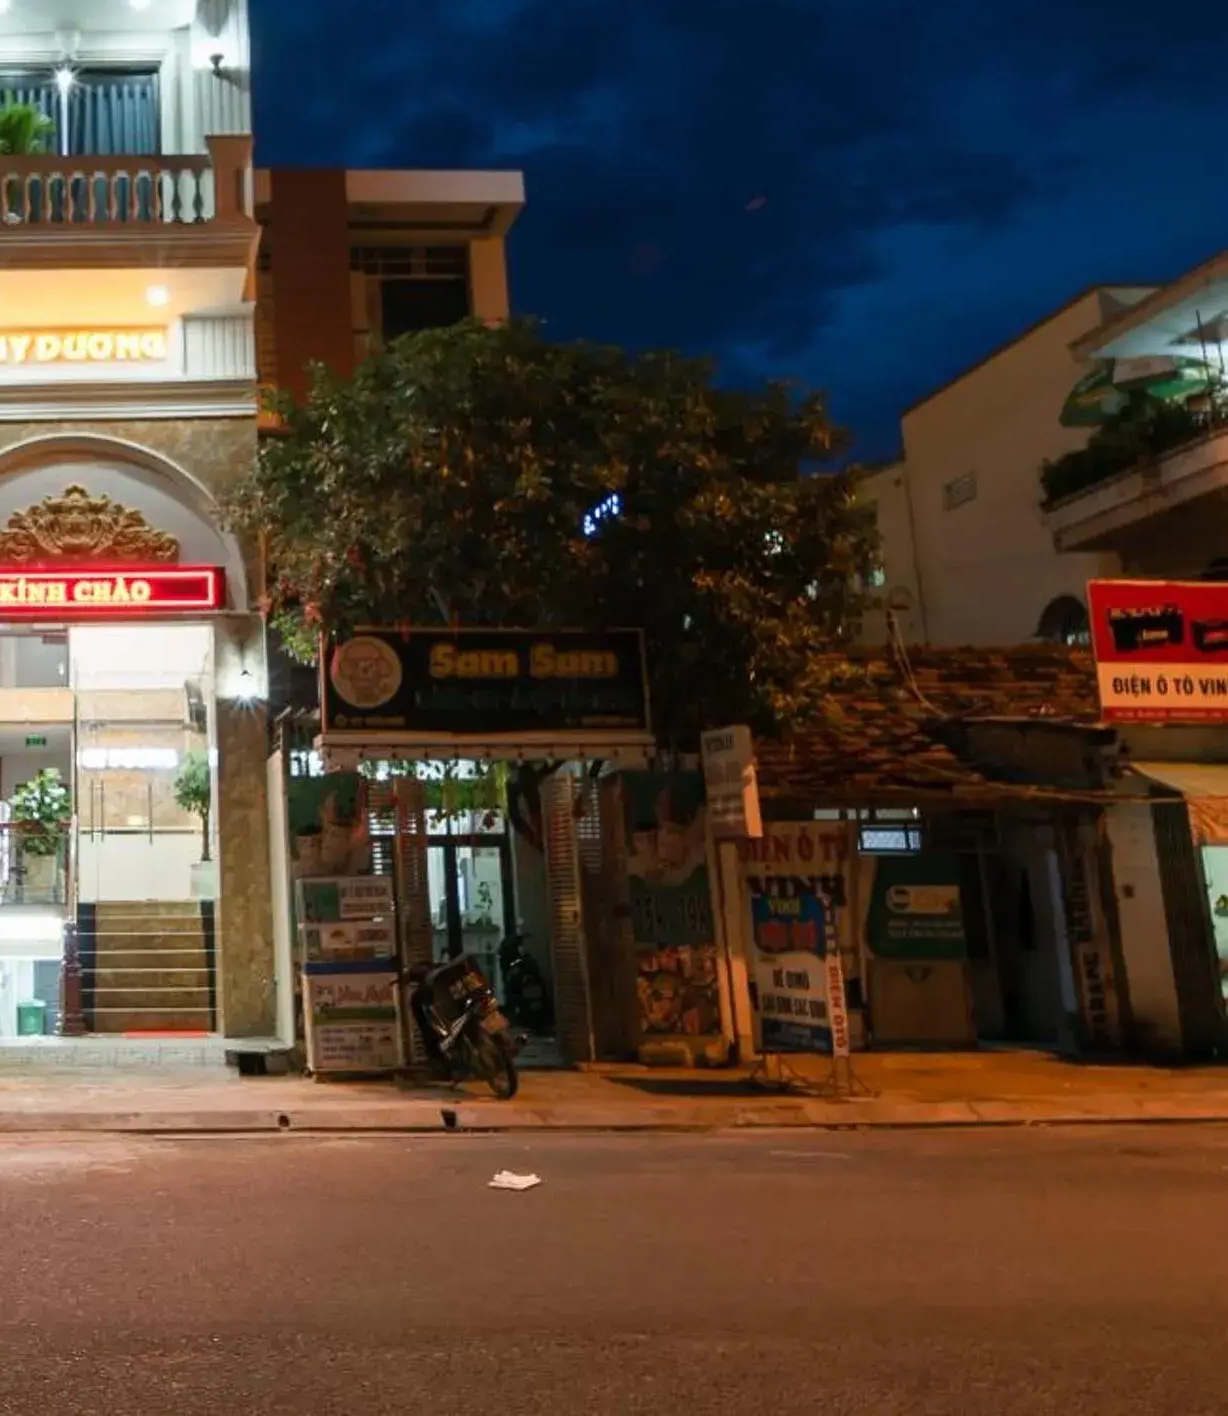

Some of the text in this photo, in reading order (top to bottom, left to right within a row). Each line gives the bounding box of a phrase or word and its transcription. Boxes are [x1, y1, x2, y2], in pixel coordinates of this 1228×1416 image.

[429, 641, 519, 679] Sam
[1112, 671, 1228, 699] ĐIỆN Ô TÔ VIN
